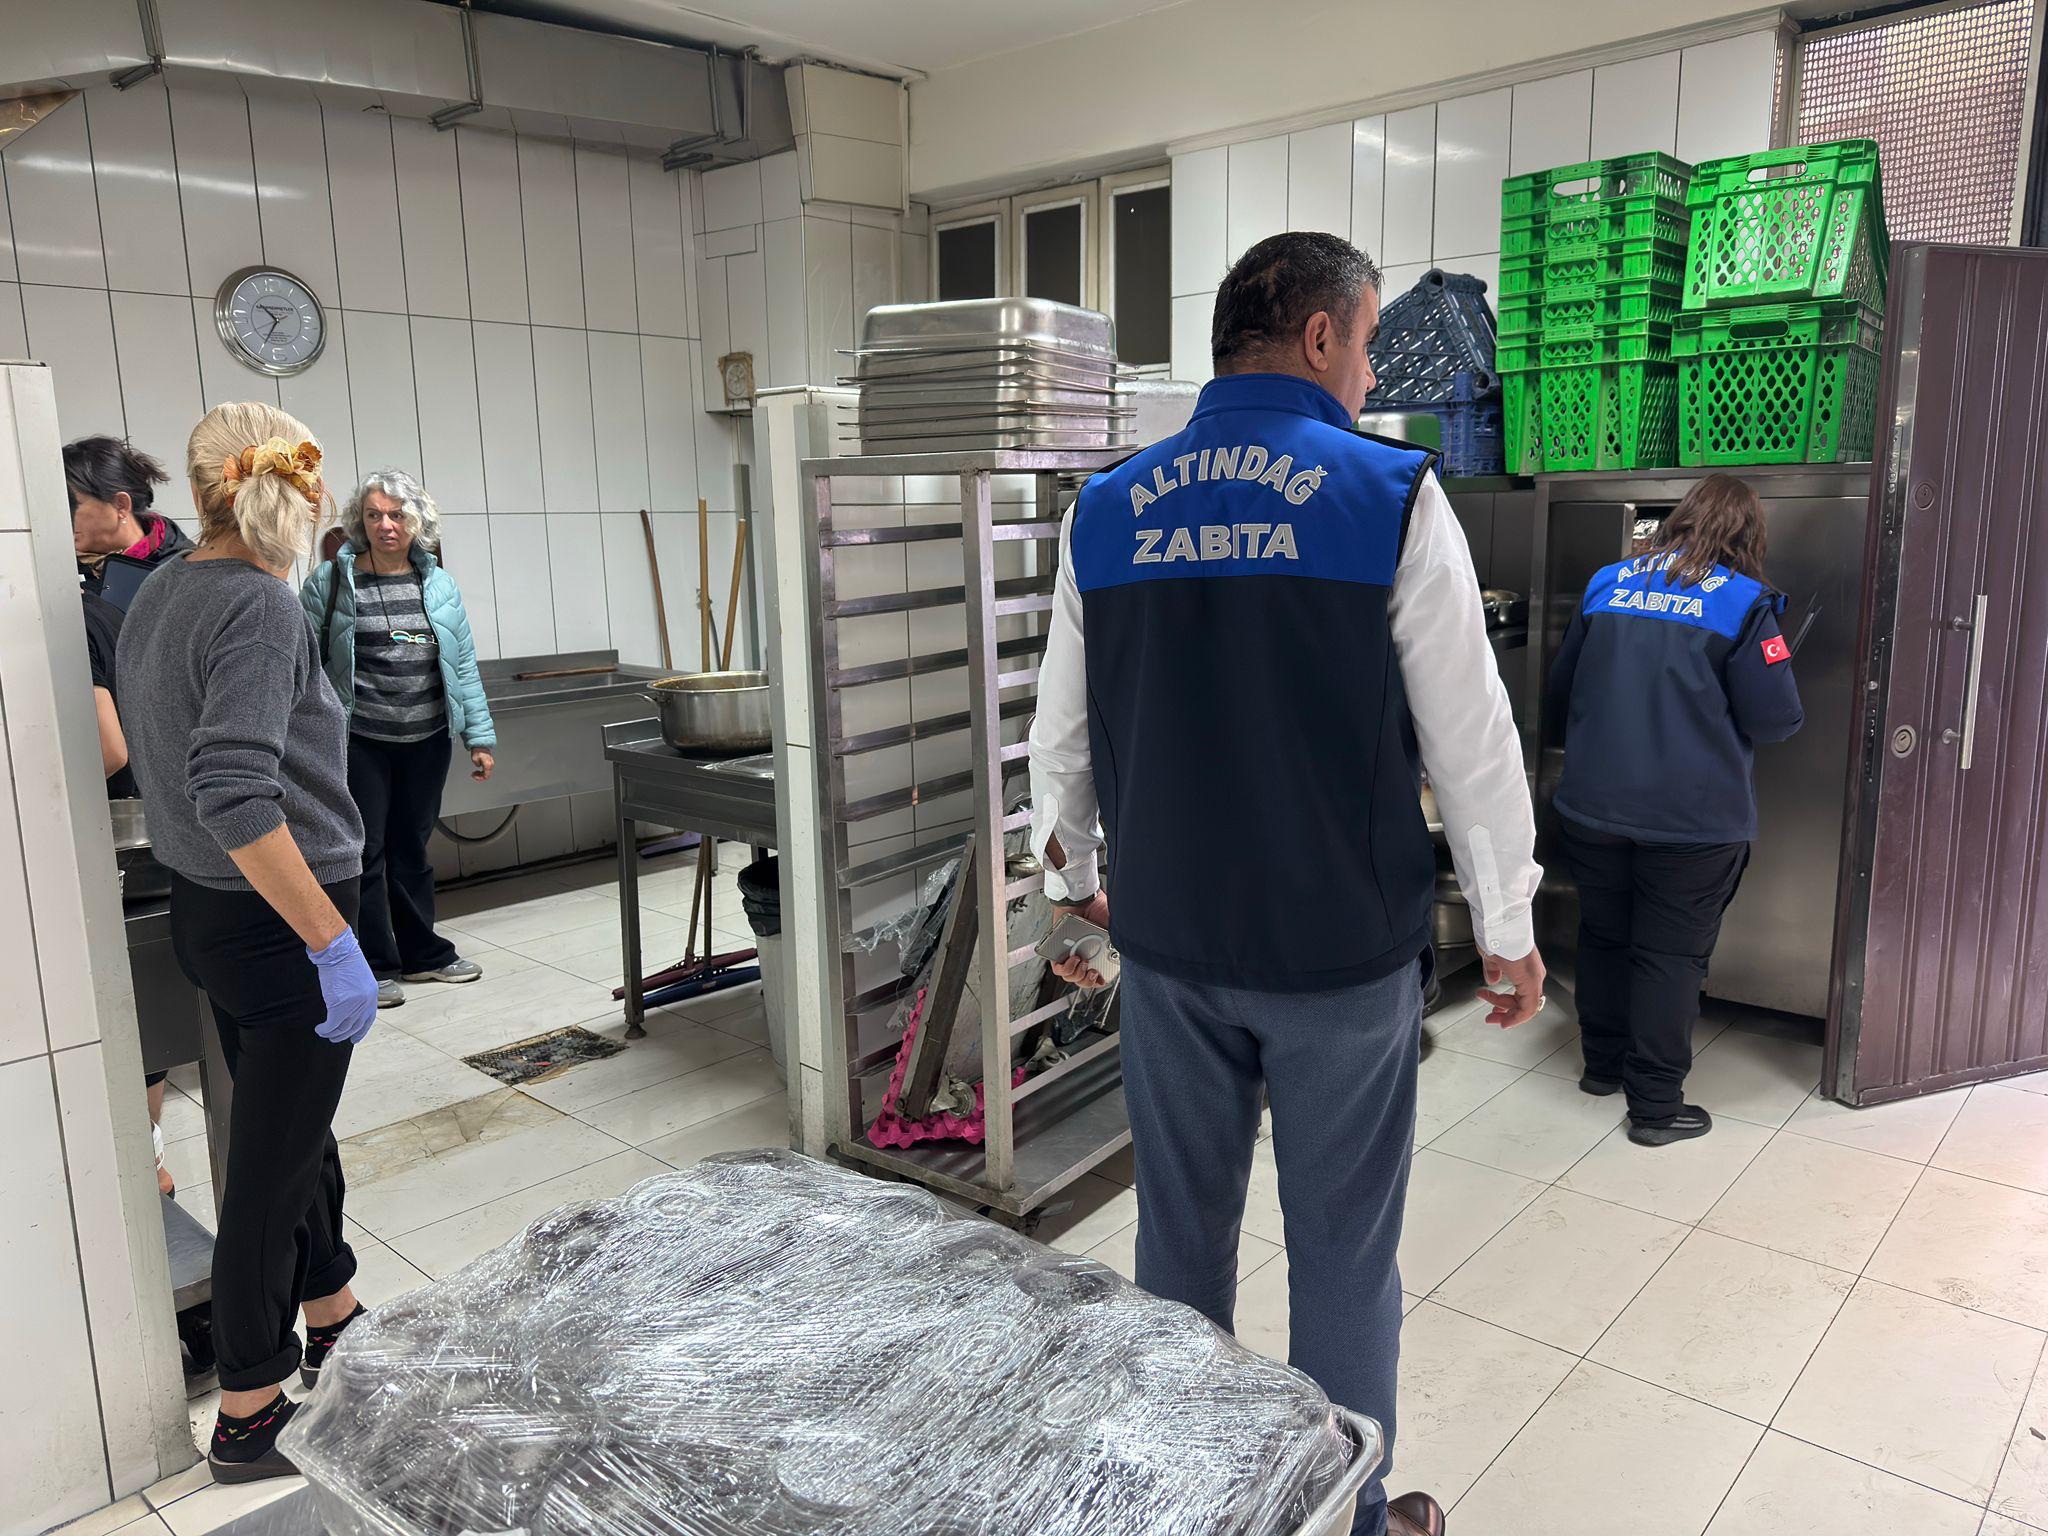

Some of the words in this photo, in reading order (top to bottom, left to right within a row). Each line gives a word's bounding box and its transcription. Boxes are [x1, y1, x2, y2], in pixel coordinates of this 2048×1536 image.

[1130, 445, 1329, 518] ALTINDAĞ
[1132, 523, 1300, 565] ZABITA
[1608, 588, 1704, 618] ZABITA
